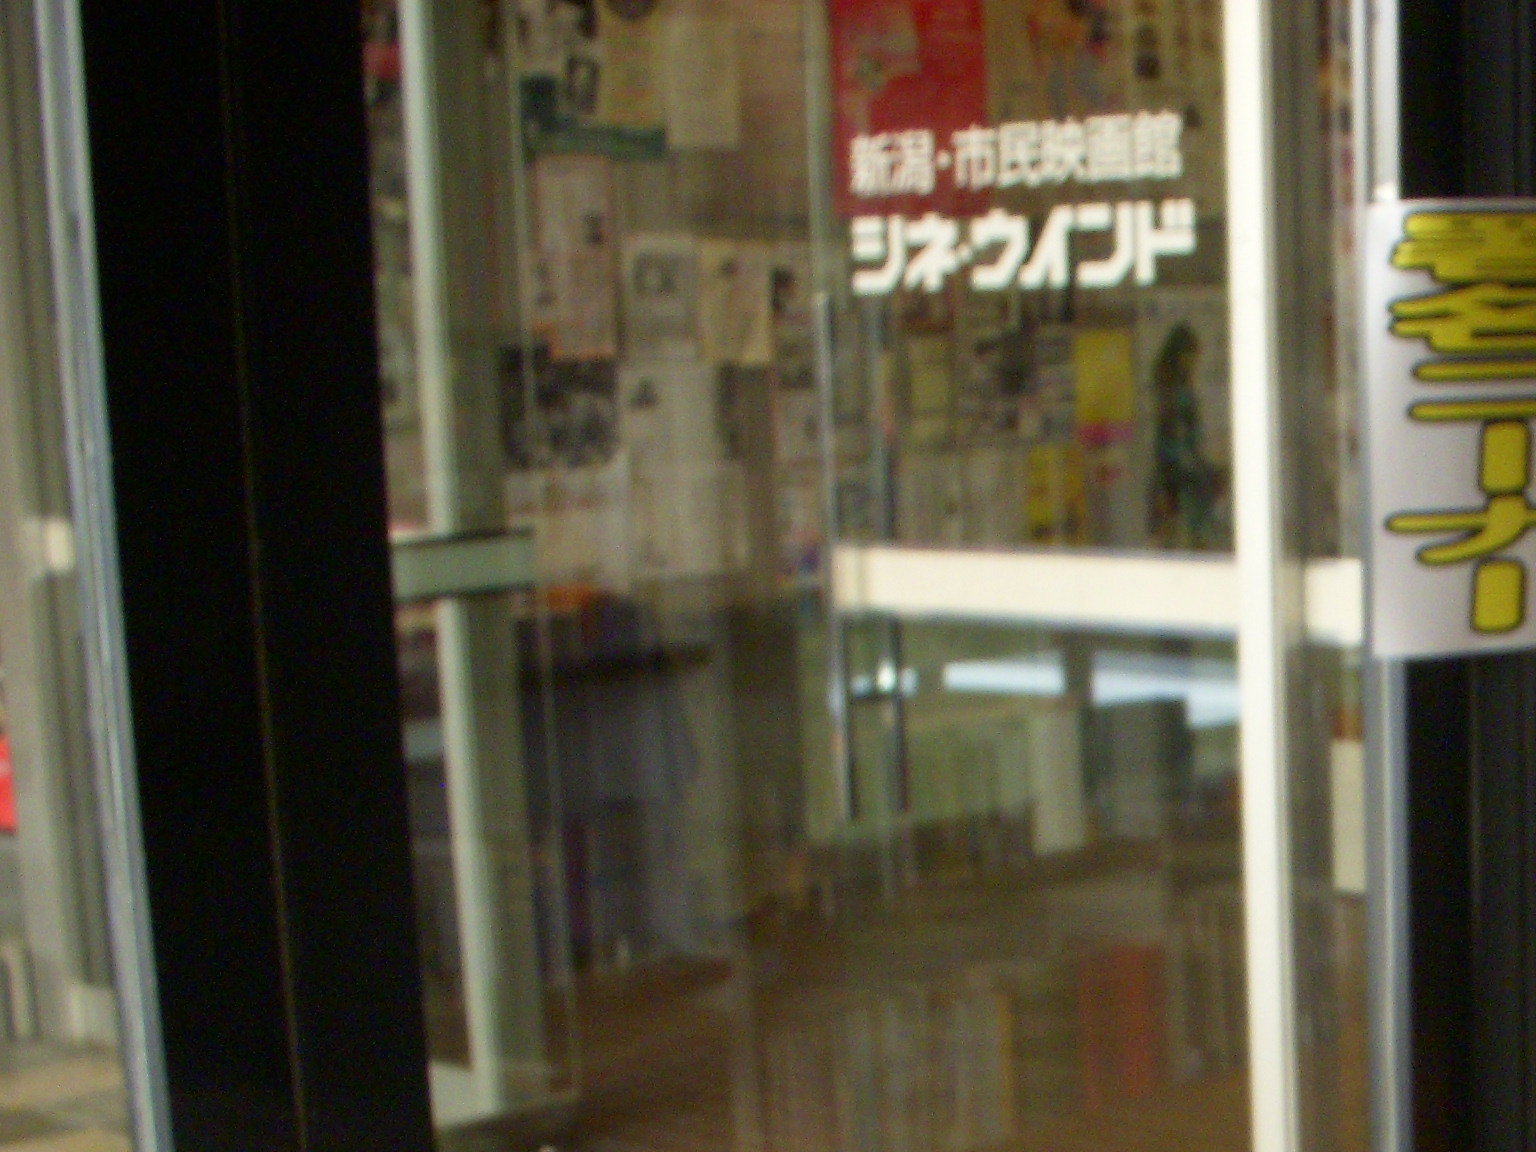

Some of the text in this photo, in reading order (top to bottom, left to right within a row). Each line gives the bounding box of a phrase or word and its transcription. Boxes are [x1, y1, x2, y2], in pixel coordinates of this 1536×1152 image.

[850, 109, 1183, 197] 新潟・市民映画館
